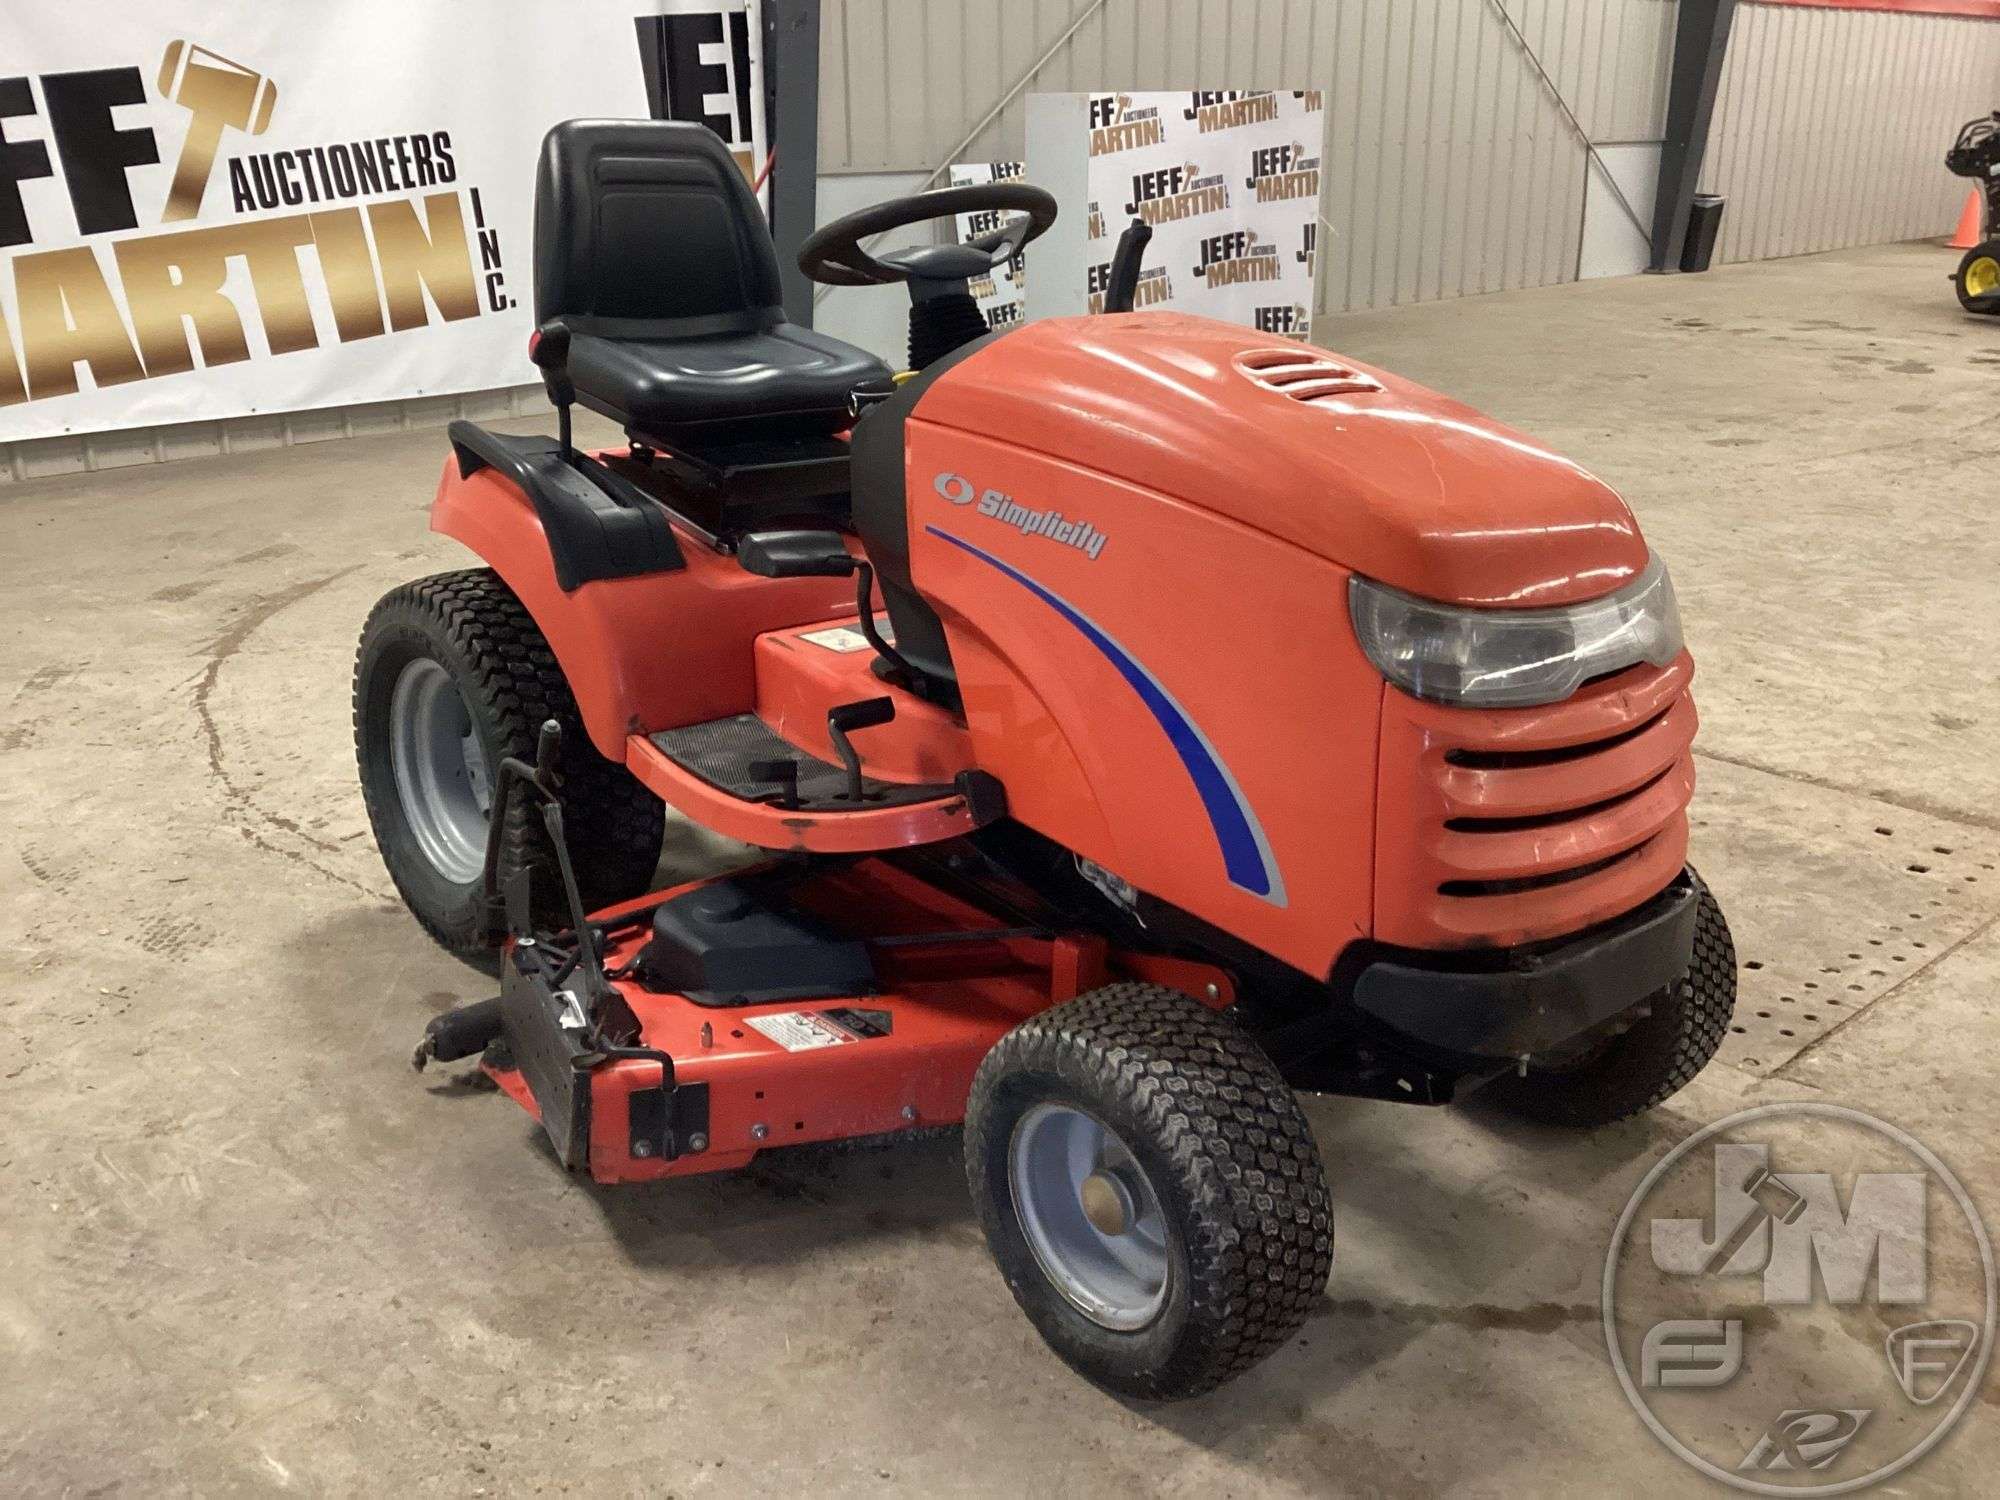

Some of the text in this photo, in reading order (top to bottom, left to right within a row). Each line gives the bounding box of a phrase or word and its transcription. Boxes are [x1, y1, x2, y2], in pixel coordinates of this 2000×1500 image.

[1198, 94, 1273, 134] MARTIN
[1090, 118, 1159, 156] ARTIN
[228, 130, 457, 214] AUCTIONEERS
[1245, 145, 1291, 189] JEFF
[1125, 166, 1182, 214] JEFF
[1139, 185, 1225, 225] MARTIN
[966, 210, 999, 241] JEFF
[1193, 231, 1245, 277] JEFF
[1206, 256, 1276, 289] MARTIN
[0, 190, 481, 406] ARTIN
[977, 489, 1108, 560] Simplicity
